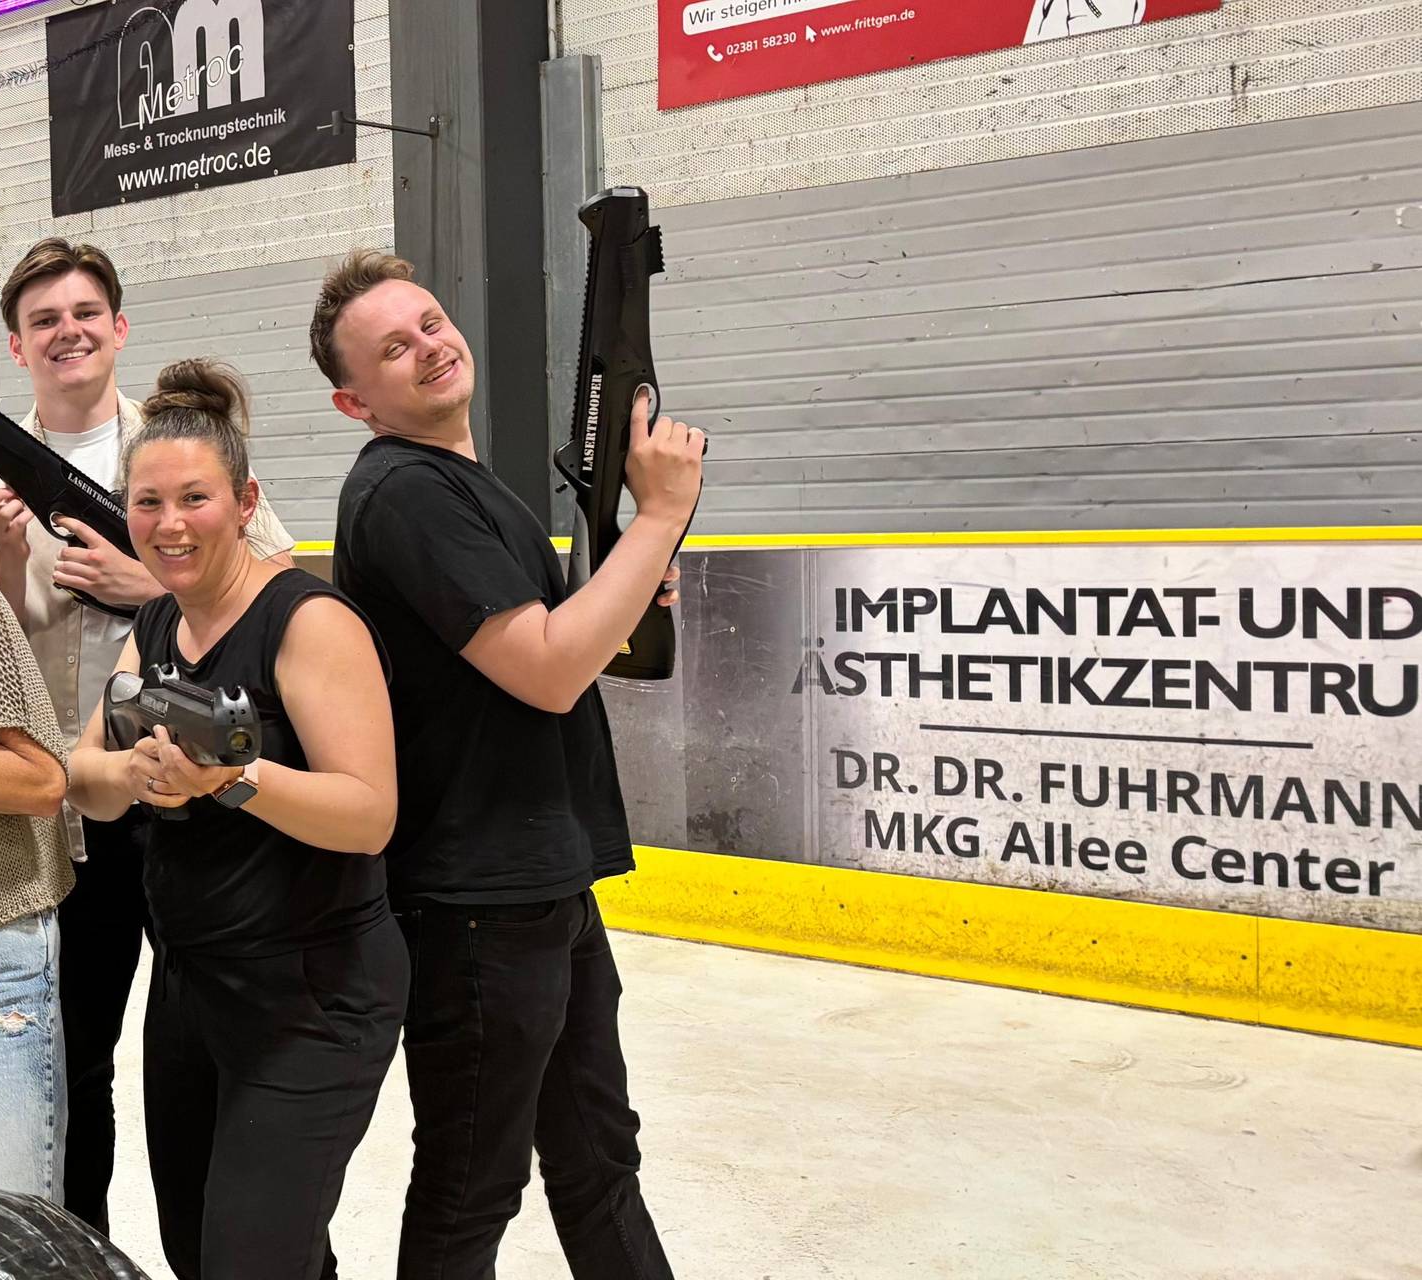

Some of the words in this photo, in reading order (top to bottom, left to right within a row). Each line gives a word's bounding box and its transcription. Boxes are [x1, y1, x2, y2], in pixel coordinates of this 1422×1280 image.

[689, 9, 715, 26] Wir
[721, 0, 776, 17] steigen
[726, 40, 758, 56] 02381
[762, 32, 797, 48] 58230
[821, 8, 915, 37] www.frittgen.de
[138, 43, 243, 130] Metroc
[104, 143, 141, 159] Mess-
[144, 136, 153, 151] &
[156, 108, 286, 147] Trocknungstechnik
[118, 142, 271, 191] www.metroc.de
[582, 374, 602, 471] LASERTROOPER
[835, 587, 1220, 637] IMPLANTAT-
[1238, 587, 1422, 640] UND
[834, 749, 919, 794] DR.
[934, 755, 1024, 802] DR.
[1040, 762, 1422, 831] FUHRMANN
[864, 810, 980, 858] MKG
[1002, 821, 1148, 874] Allee
[1171, 835, 1395, 896] Center
